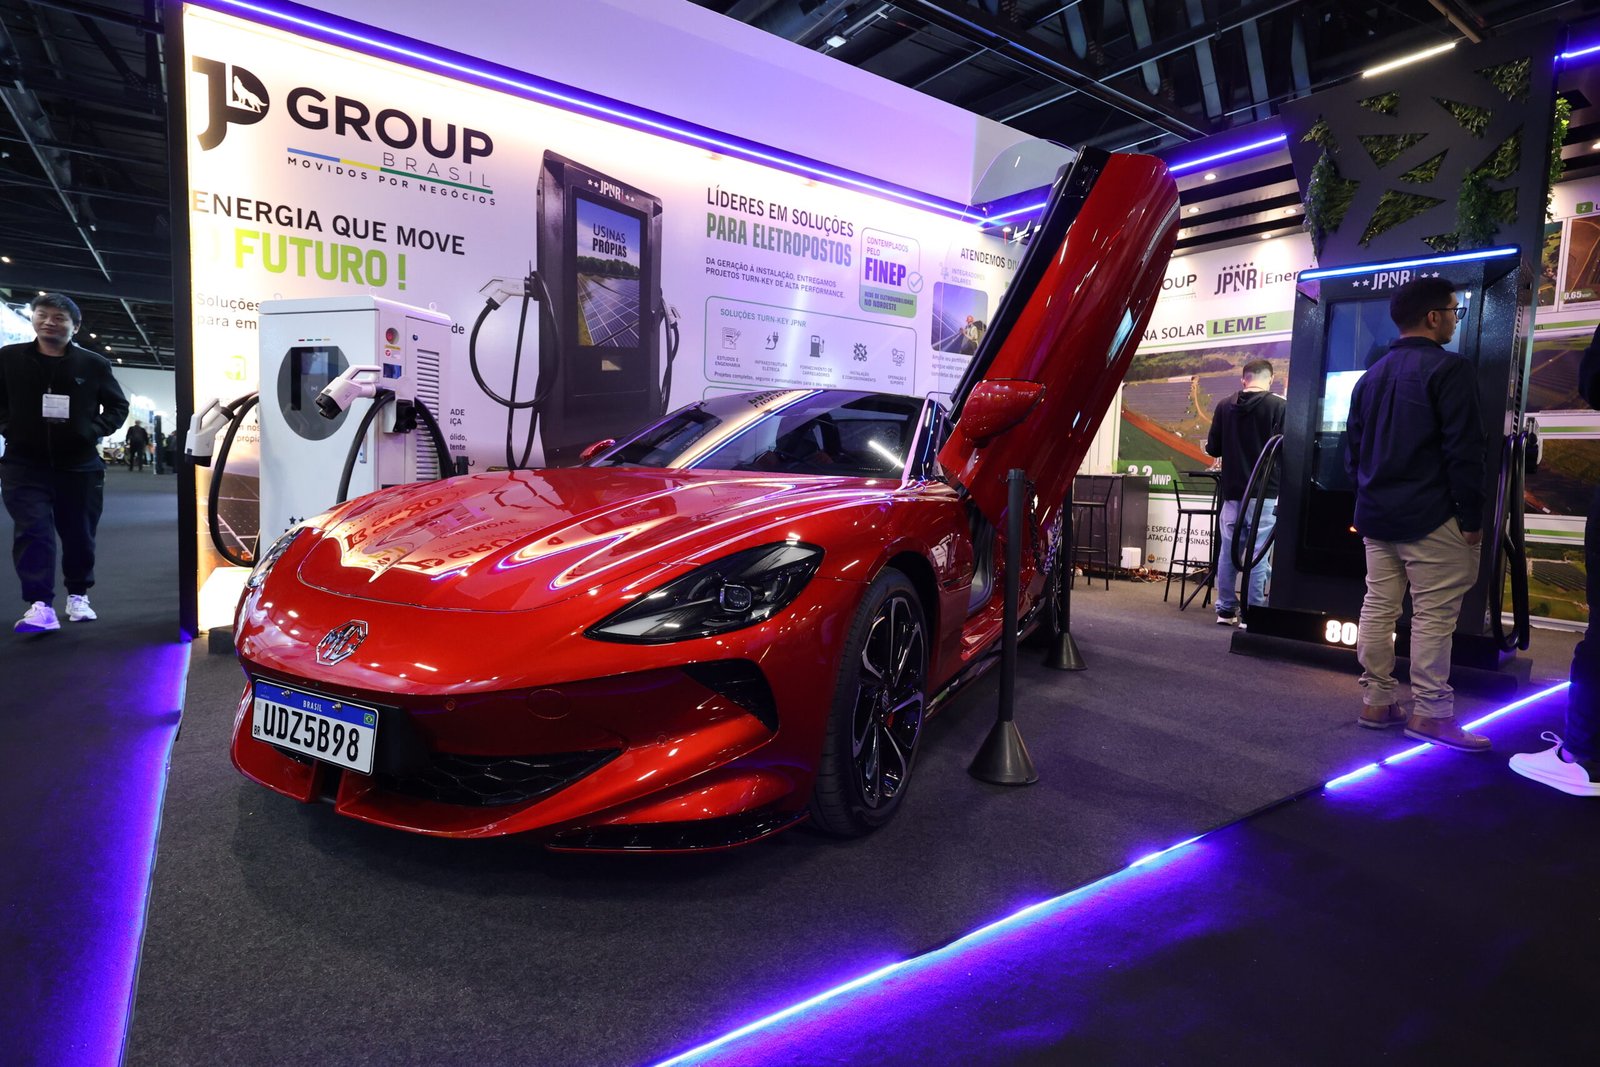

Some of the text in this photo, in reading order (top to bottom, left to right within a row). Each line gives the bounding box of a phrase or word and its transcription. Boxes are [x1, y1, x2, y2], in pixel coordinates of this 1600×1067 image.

[286, 86, 494, 164] GROUP
[383, 152, 491, 188] BRASIL
[287, 157, 496, 206] MOVIDOS POR NEGÓCIOS
[707, 184, 854, 237] LÍDERES EM SOLUÇÕES
[192, 190, 466, 256] ENERGIA QUE MOVE
[593, 222, 626, 244] USINAS
[592, 237, 627, 258] PRÓPIAS
[706, 212, 852, 267] PARA ELETROPOSTOS
[866, 236, 909, 253] CONTEMPLADOS
[234, 227, 388, 287] FUTURO
[866, 246, 881, 257] PELO
[960, 248, 1019, 270] ATENDEMOS DIV
[706, 257, 716, 265] DA
[717, 259, 748, 272] GERAÇÃO
[797, 274, 837, 288] ENTREGAMOS
[865, 257, 907, 286] FINEP
[1162, 273, 1198, 290] OUP
[1214, 268, 1299, 296] JPNR Ener
[1371, 269, 1411, 291] JPNR
[705, 267, 846, 299] PROJETOS TURN-KEY DE ALTA PERFORMANCE.
[720, 308, 756, 320] SOLUÇÕES
[451, 323, 465, 335] de
[1141, 315, 1267, 342] NA SOLAR LEME
[450, 408, 465, 416] ADE
[449, 433, 468, 441] ólido,
[449, 443, 466, 451] tente
[302, 700, 323, 712] BRASIL
[253, 724, 261, 736] BR
[263, 703, 360, 762] UDZ5B98
